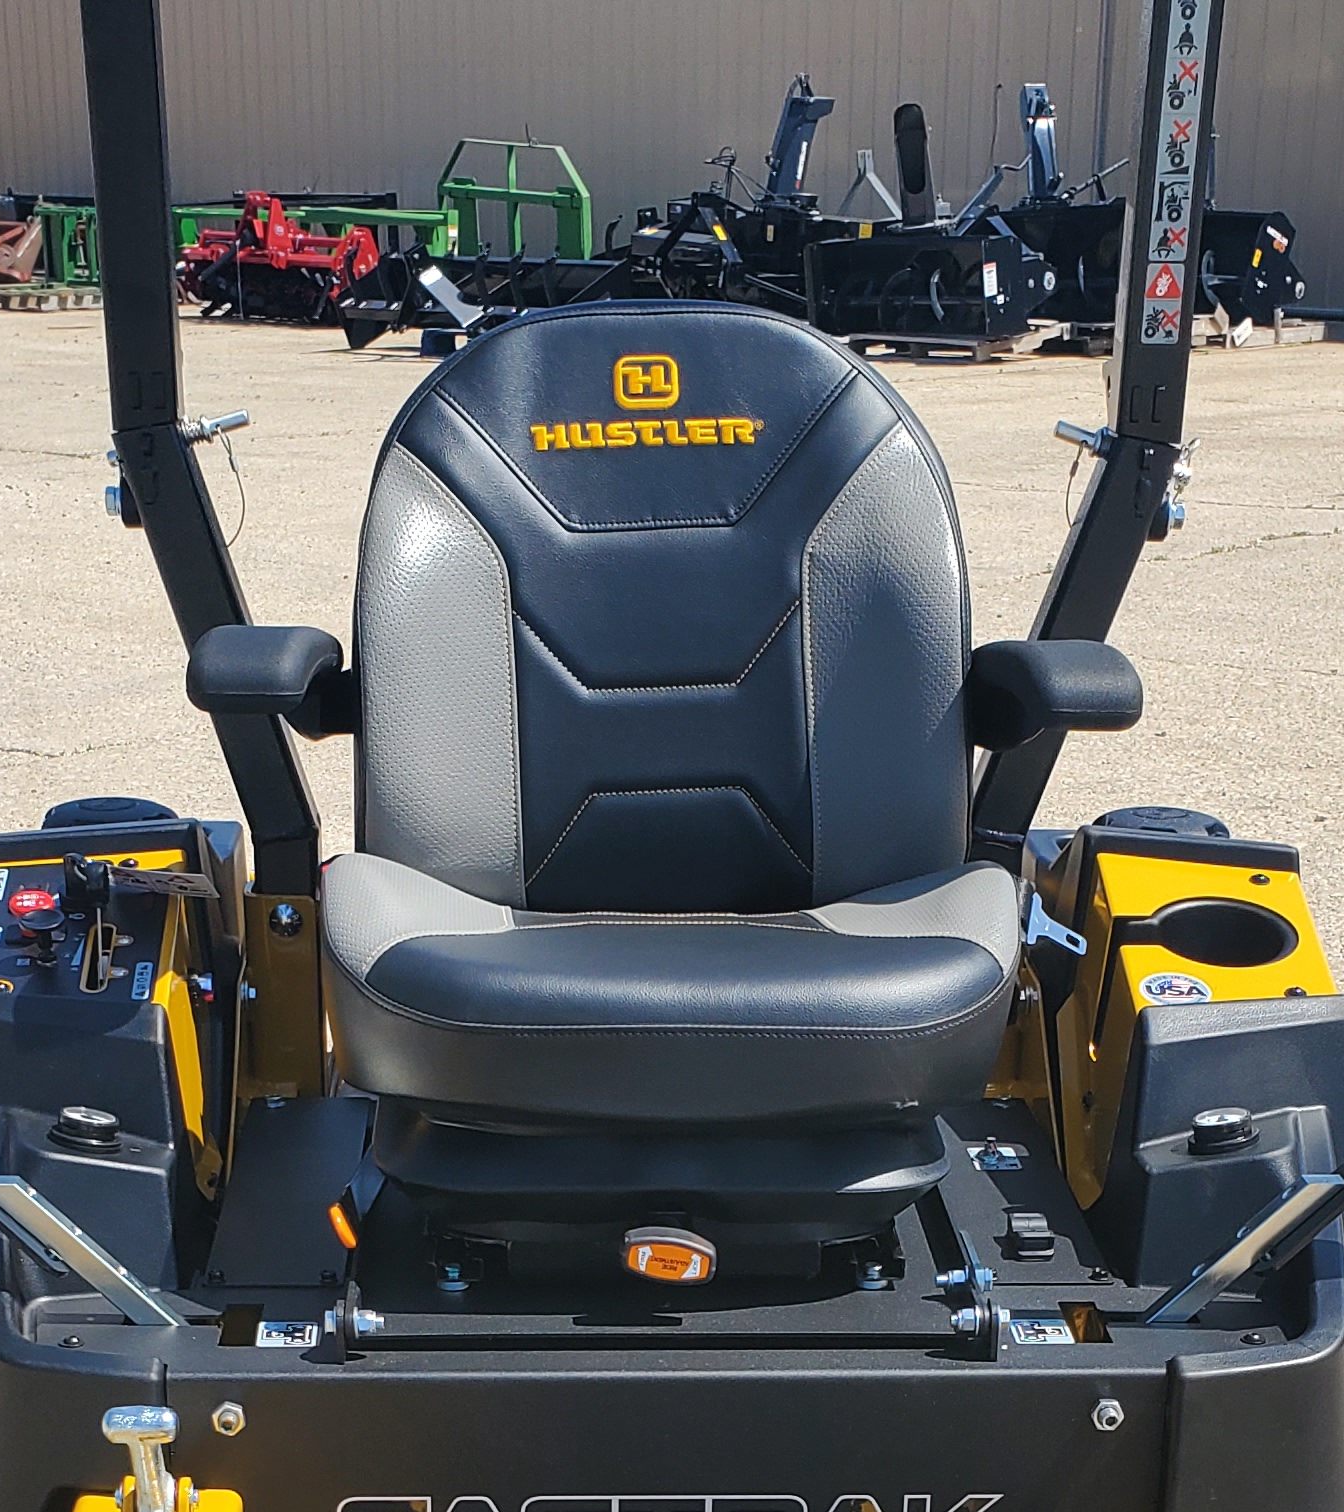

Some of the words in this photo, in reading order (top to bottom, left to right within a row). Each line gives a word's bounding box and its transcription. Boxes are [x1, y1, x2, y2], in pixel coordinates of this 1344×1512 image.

[1145, 983, 1207, 996] USA
[650, 1256, 690, 1267] ADJUSTMENT
[661, 1263, 677, 1271] RIDE
